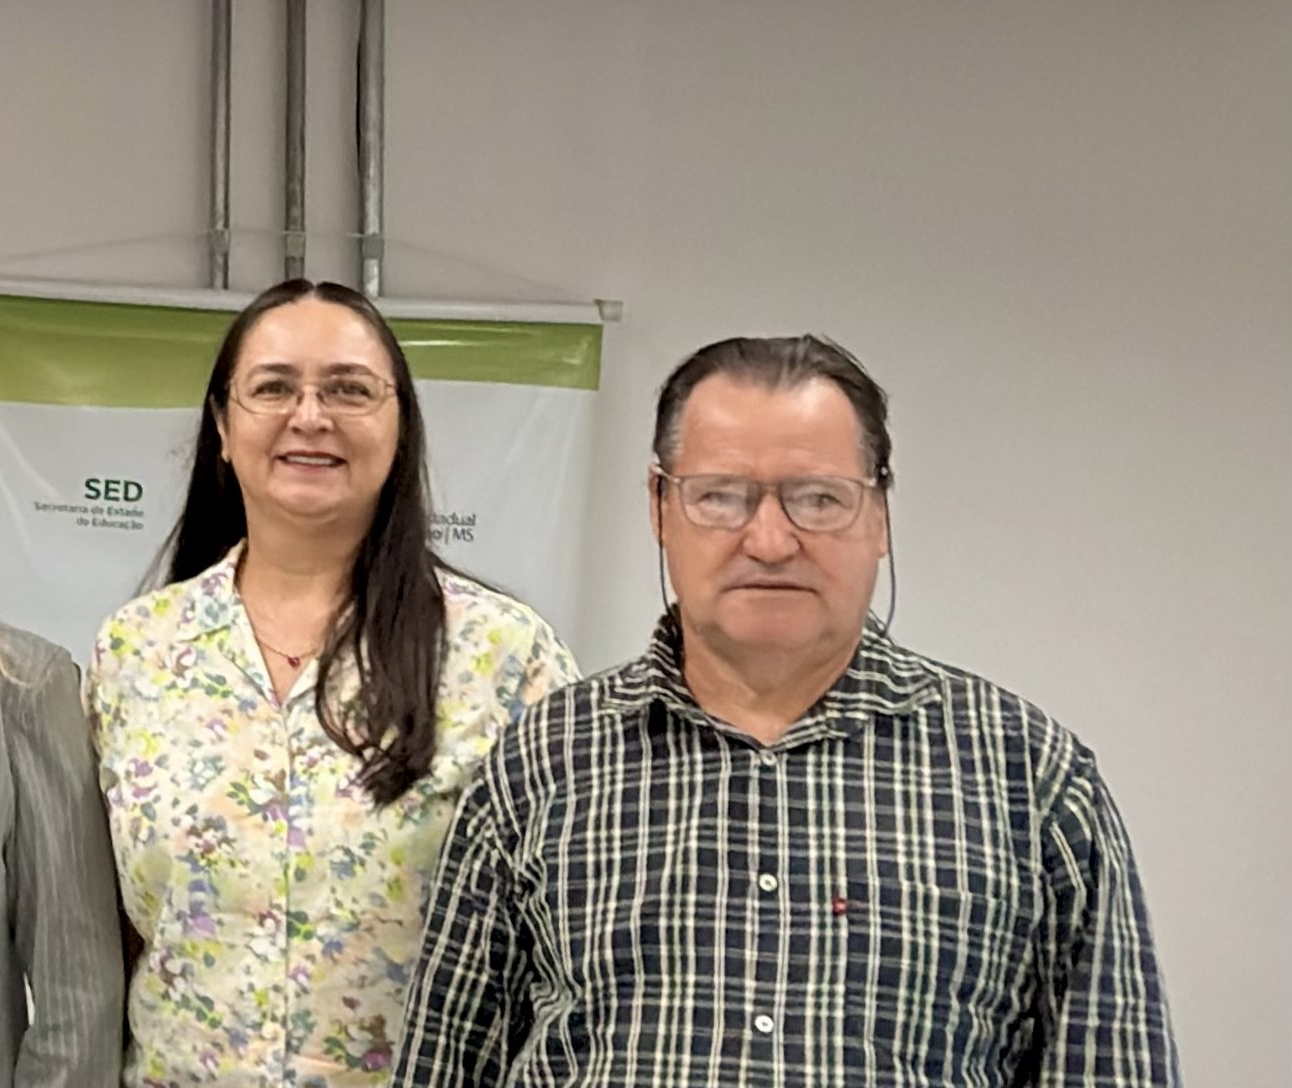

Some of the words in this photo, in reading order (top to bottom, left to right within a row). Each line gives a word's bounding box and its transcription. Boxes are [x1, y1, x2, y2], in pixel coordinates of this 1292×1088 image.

[84, 478, 144, 503] SED
[35, 502, 89, 513] Secretaria
[107, 507, 144, 517] Estado
[92, 518, 144, 530] Educação
